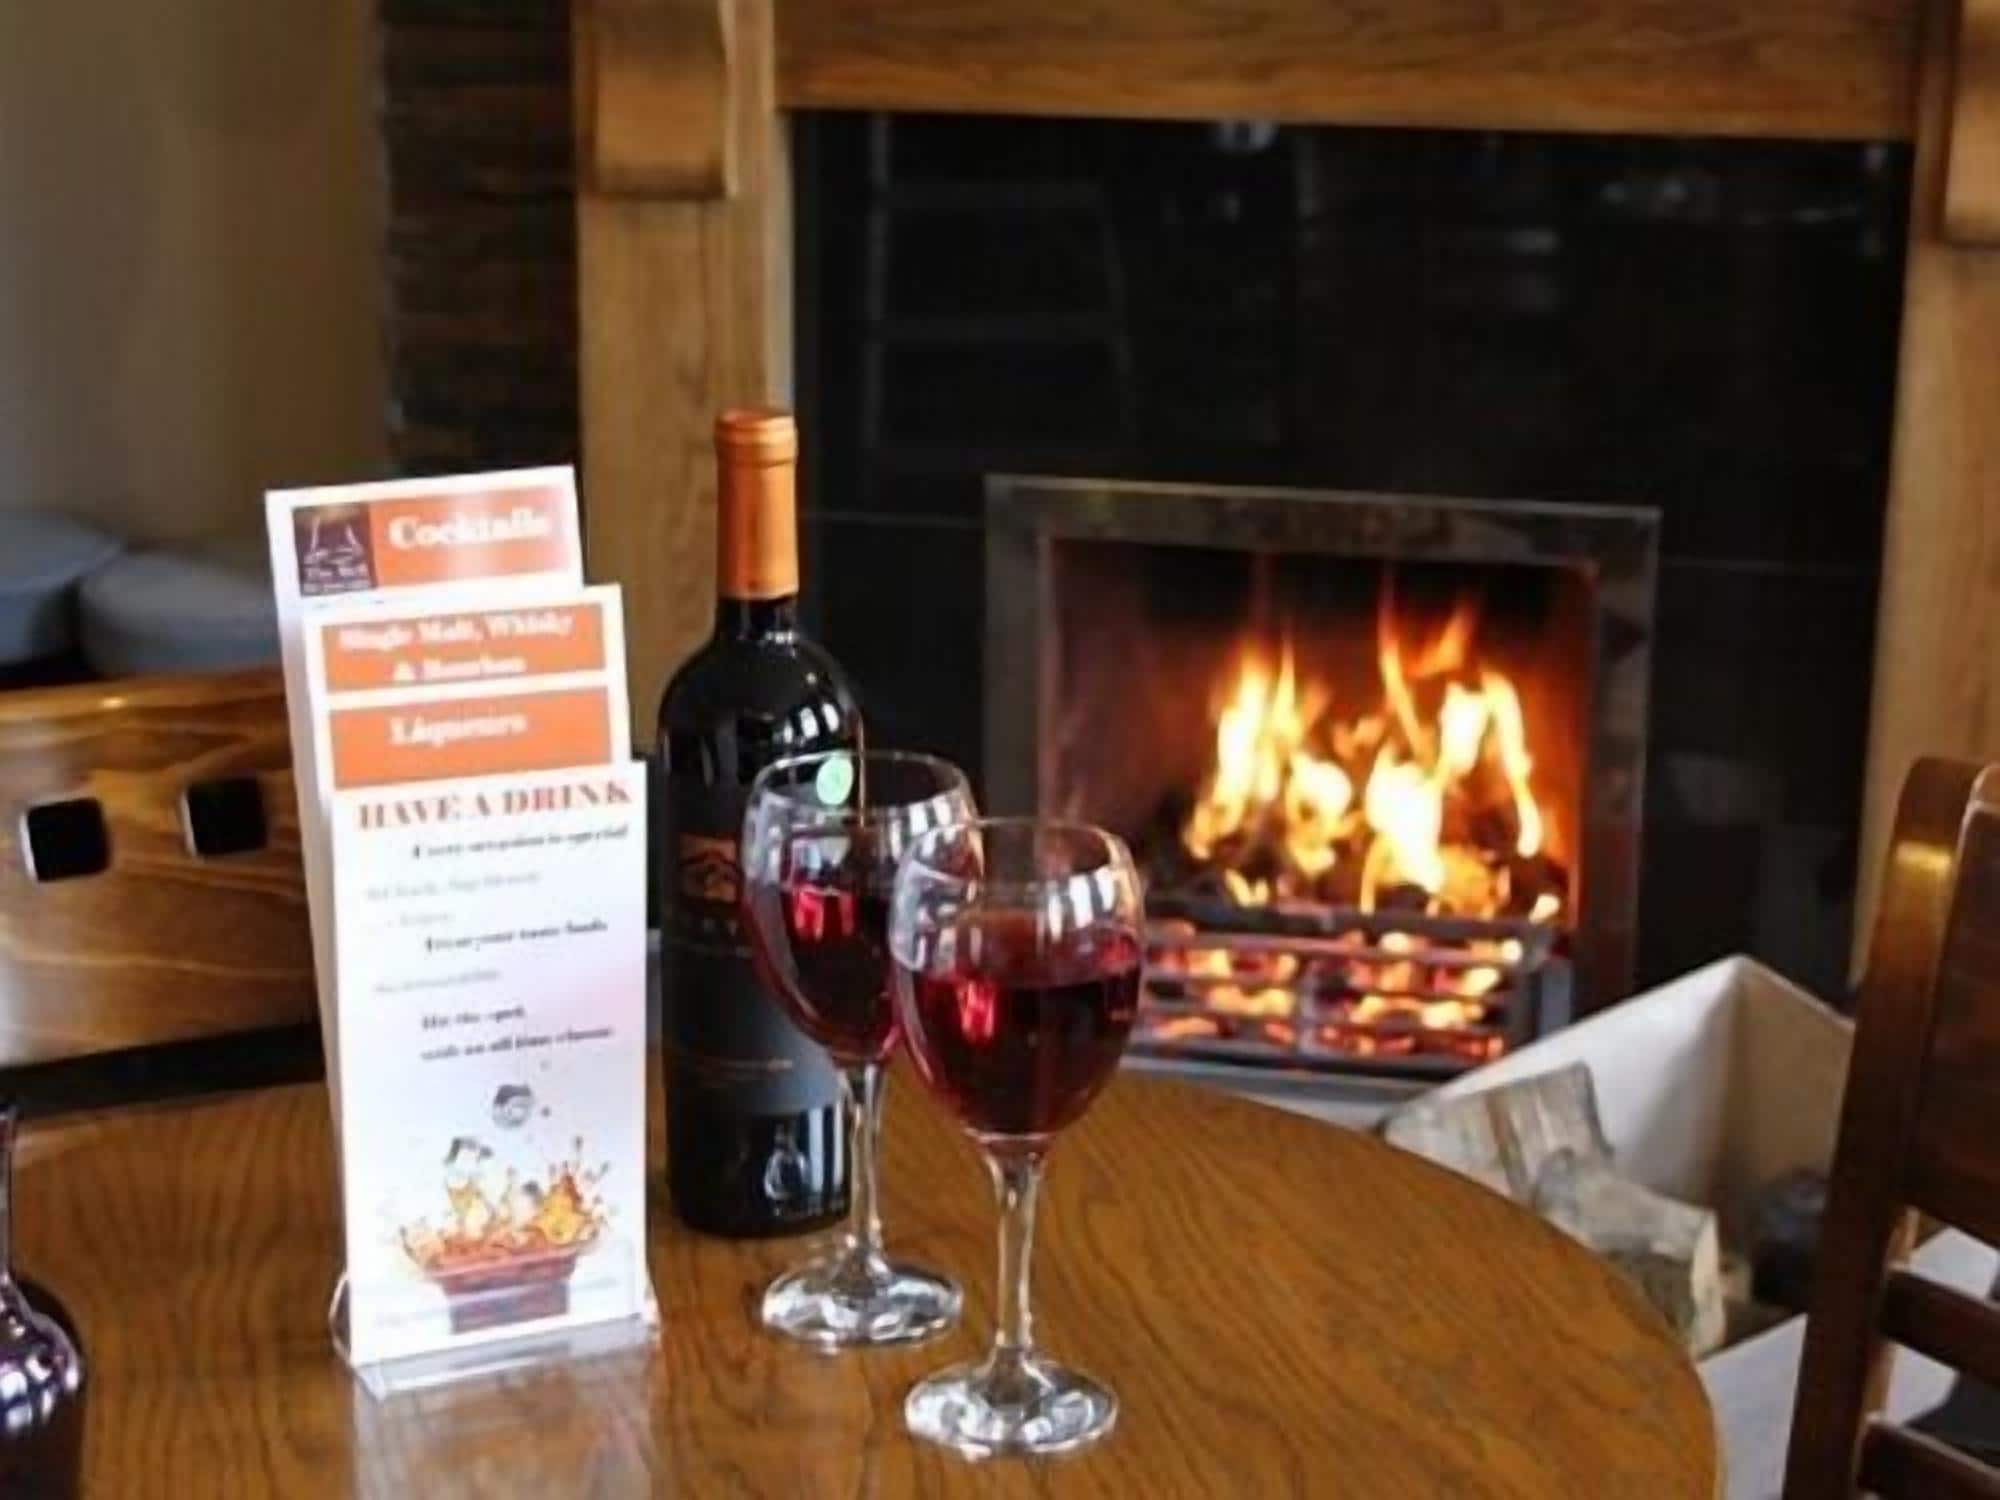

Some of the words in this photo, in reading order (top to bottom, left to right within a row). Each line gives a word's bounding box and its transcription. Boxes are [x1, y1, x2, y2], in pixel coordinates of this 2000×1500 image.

[359, 796, 461, 828] HAVE
[467, 794, 491, 818] A
[503, 781, 630, 815] DRINK
